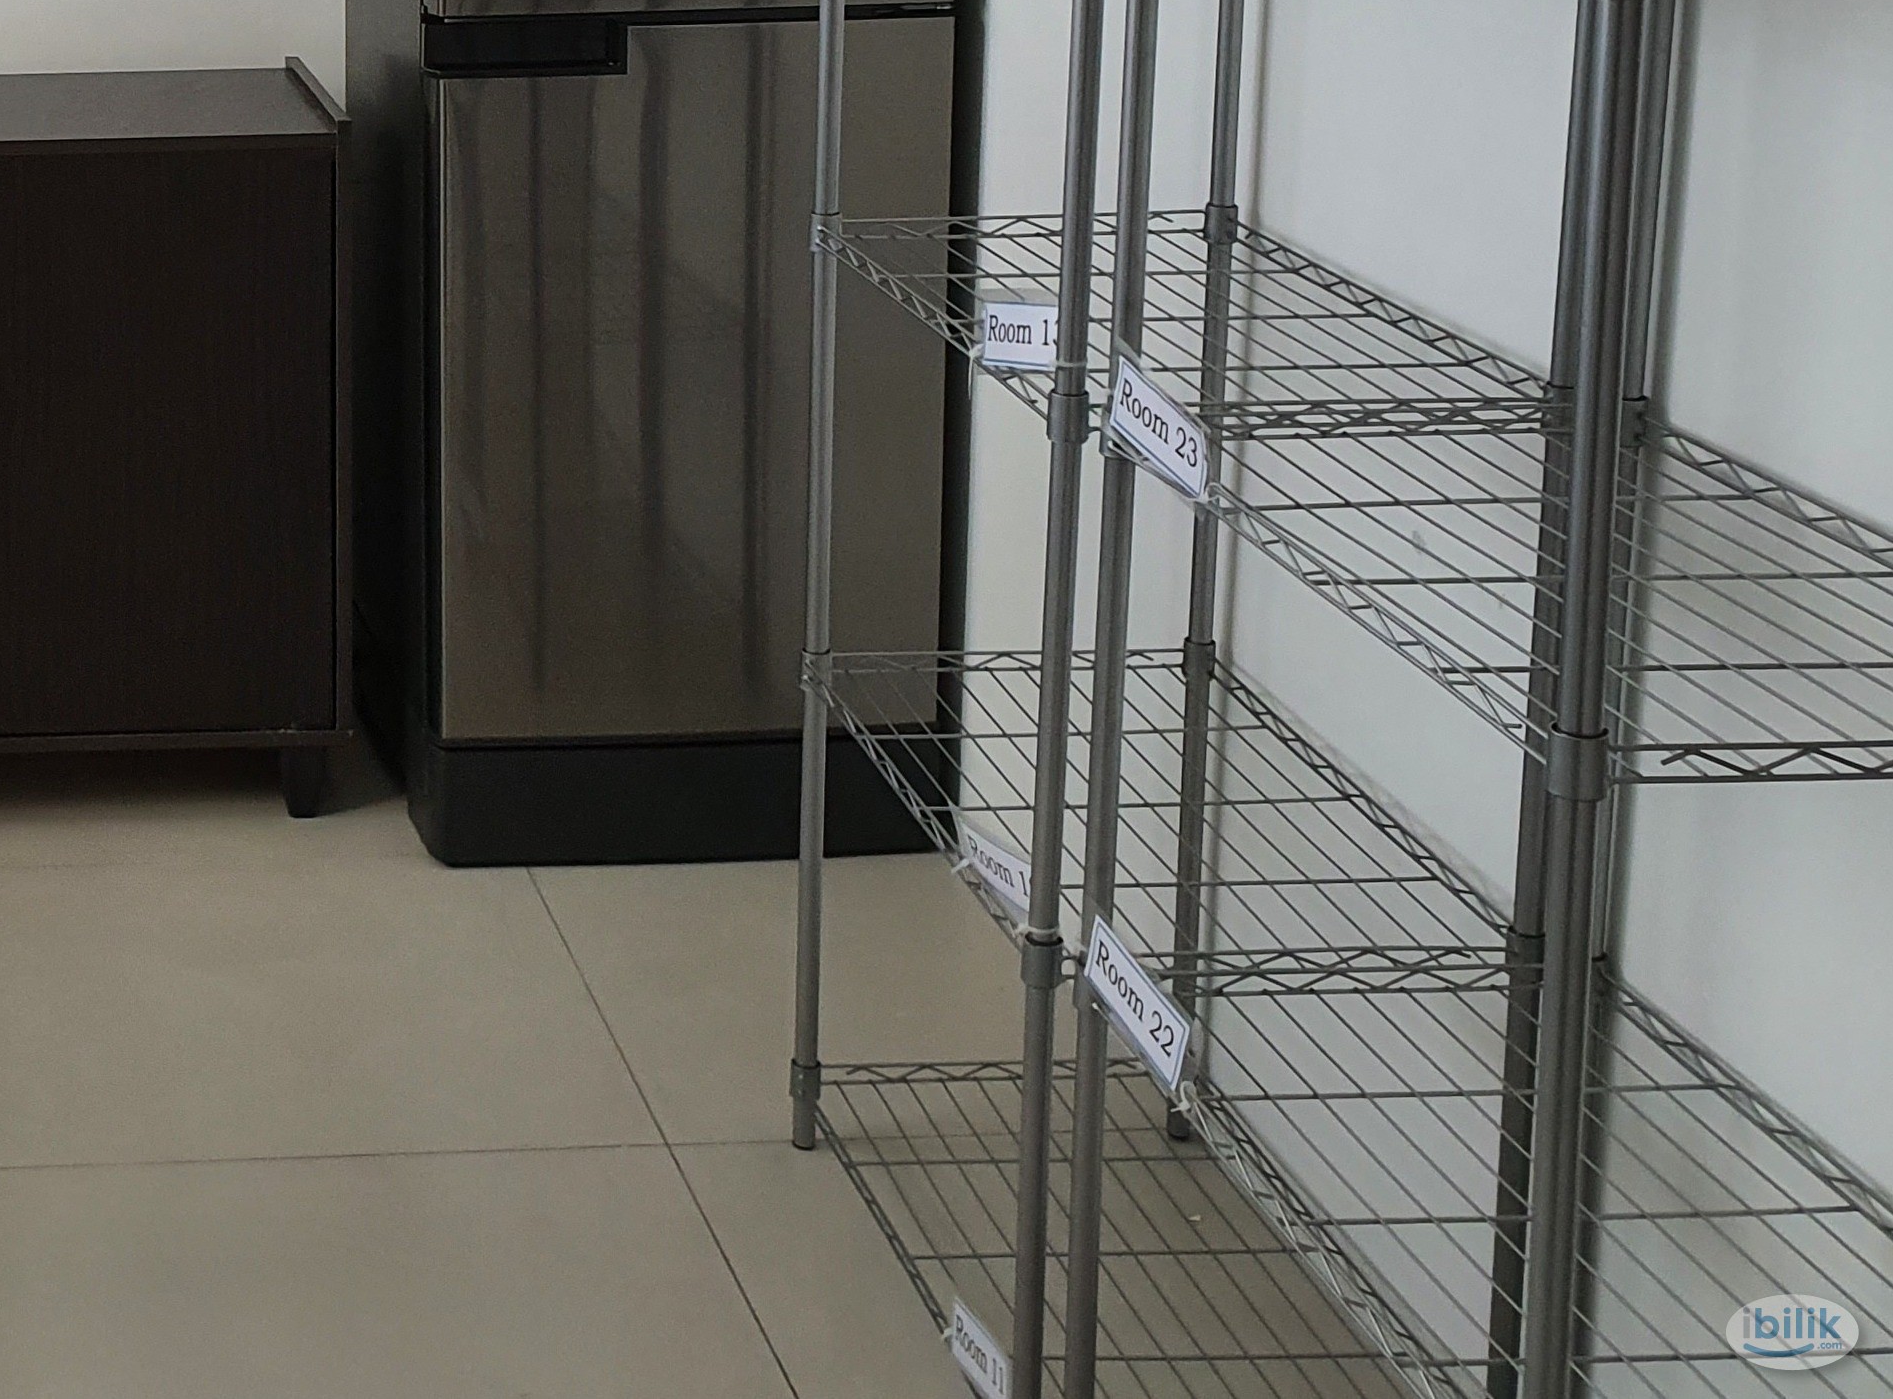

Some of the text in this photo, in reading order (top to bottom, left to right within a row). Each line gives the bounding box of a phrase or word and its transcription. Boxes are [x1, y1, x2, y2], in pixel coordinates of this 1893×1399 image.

[987, 315, 1032, 344] Room
[1119, 378, 1198, 467] Room 23
[968, 834, 1015, 888] Room
[1095, 940, 1175, 1058] Room 22
[955, 1314, 1005, 1396] Room 11
